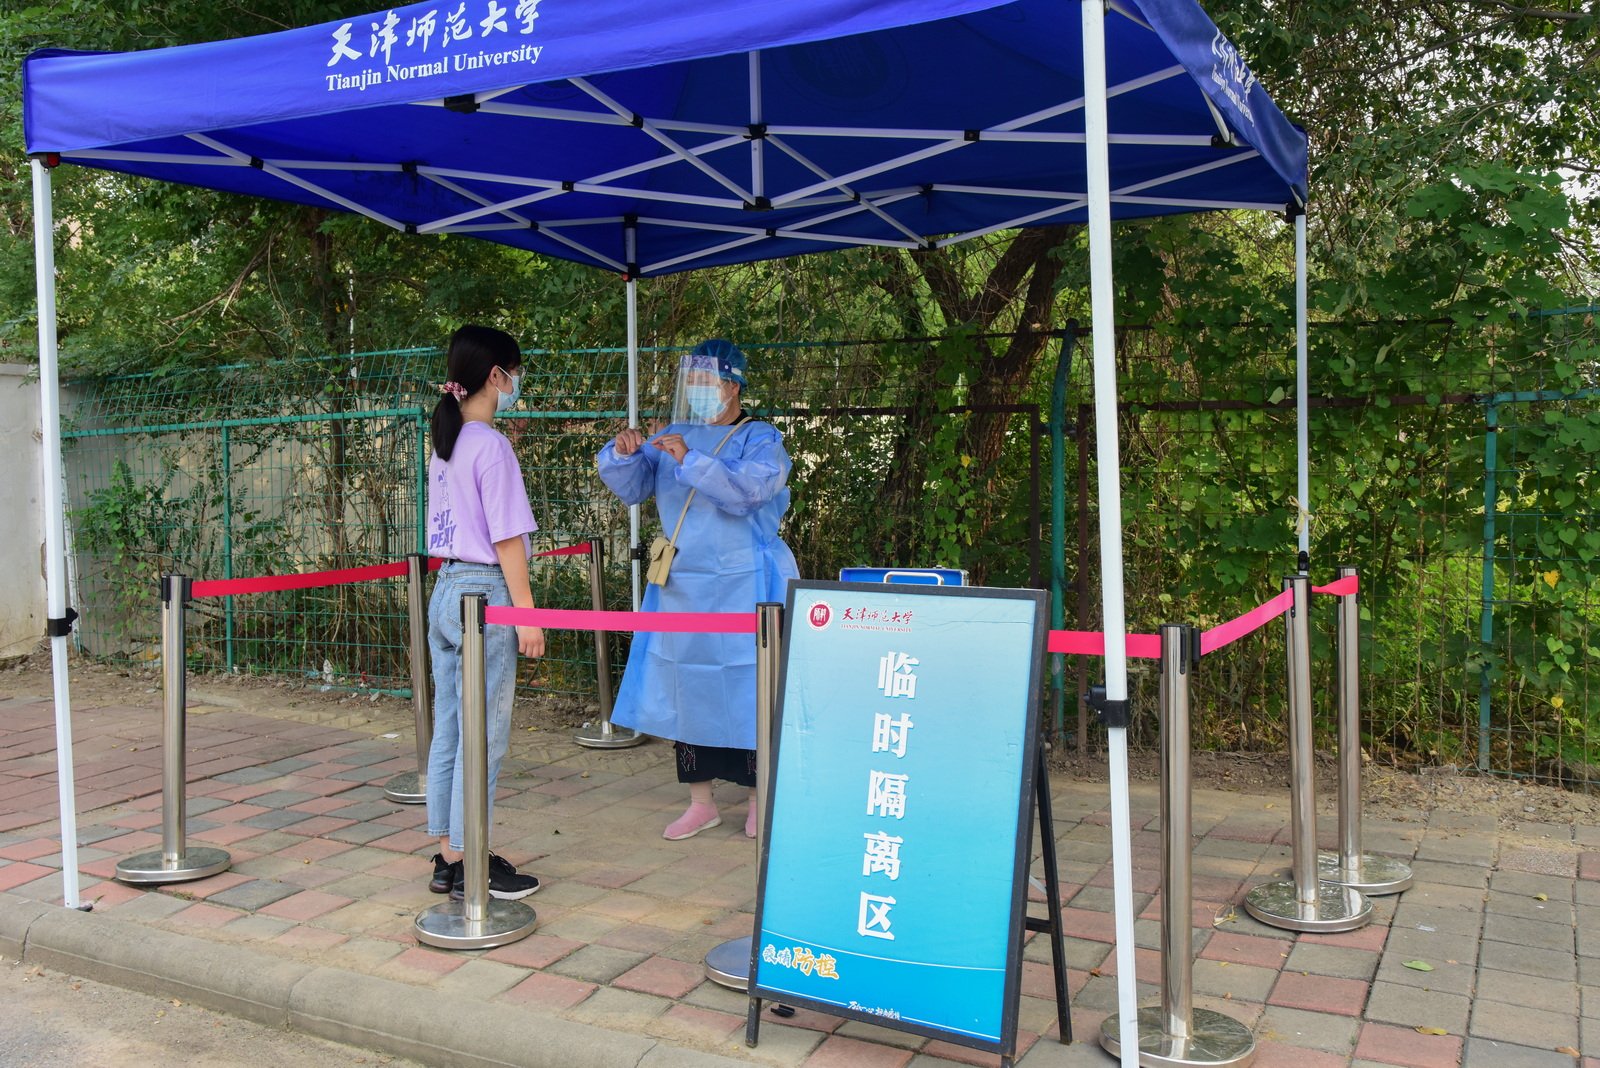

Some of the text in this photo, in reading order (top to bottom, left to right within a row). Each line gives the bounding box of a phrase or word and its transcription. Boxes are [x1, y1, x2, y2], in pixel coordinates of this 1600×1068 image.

[327, 0, 542, 67] 天津师范大学
[326, 44, 543, 91] Tianjin Normal University
[842, 607, 913, 625] 天津师范大学
[857, 651, 919, 941] 临时隔离区
[762, 944, 840, 980] 疫情防控
